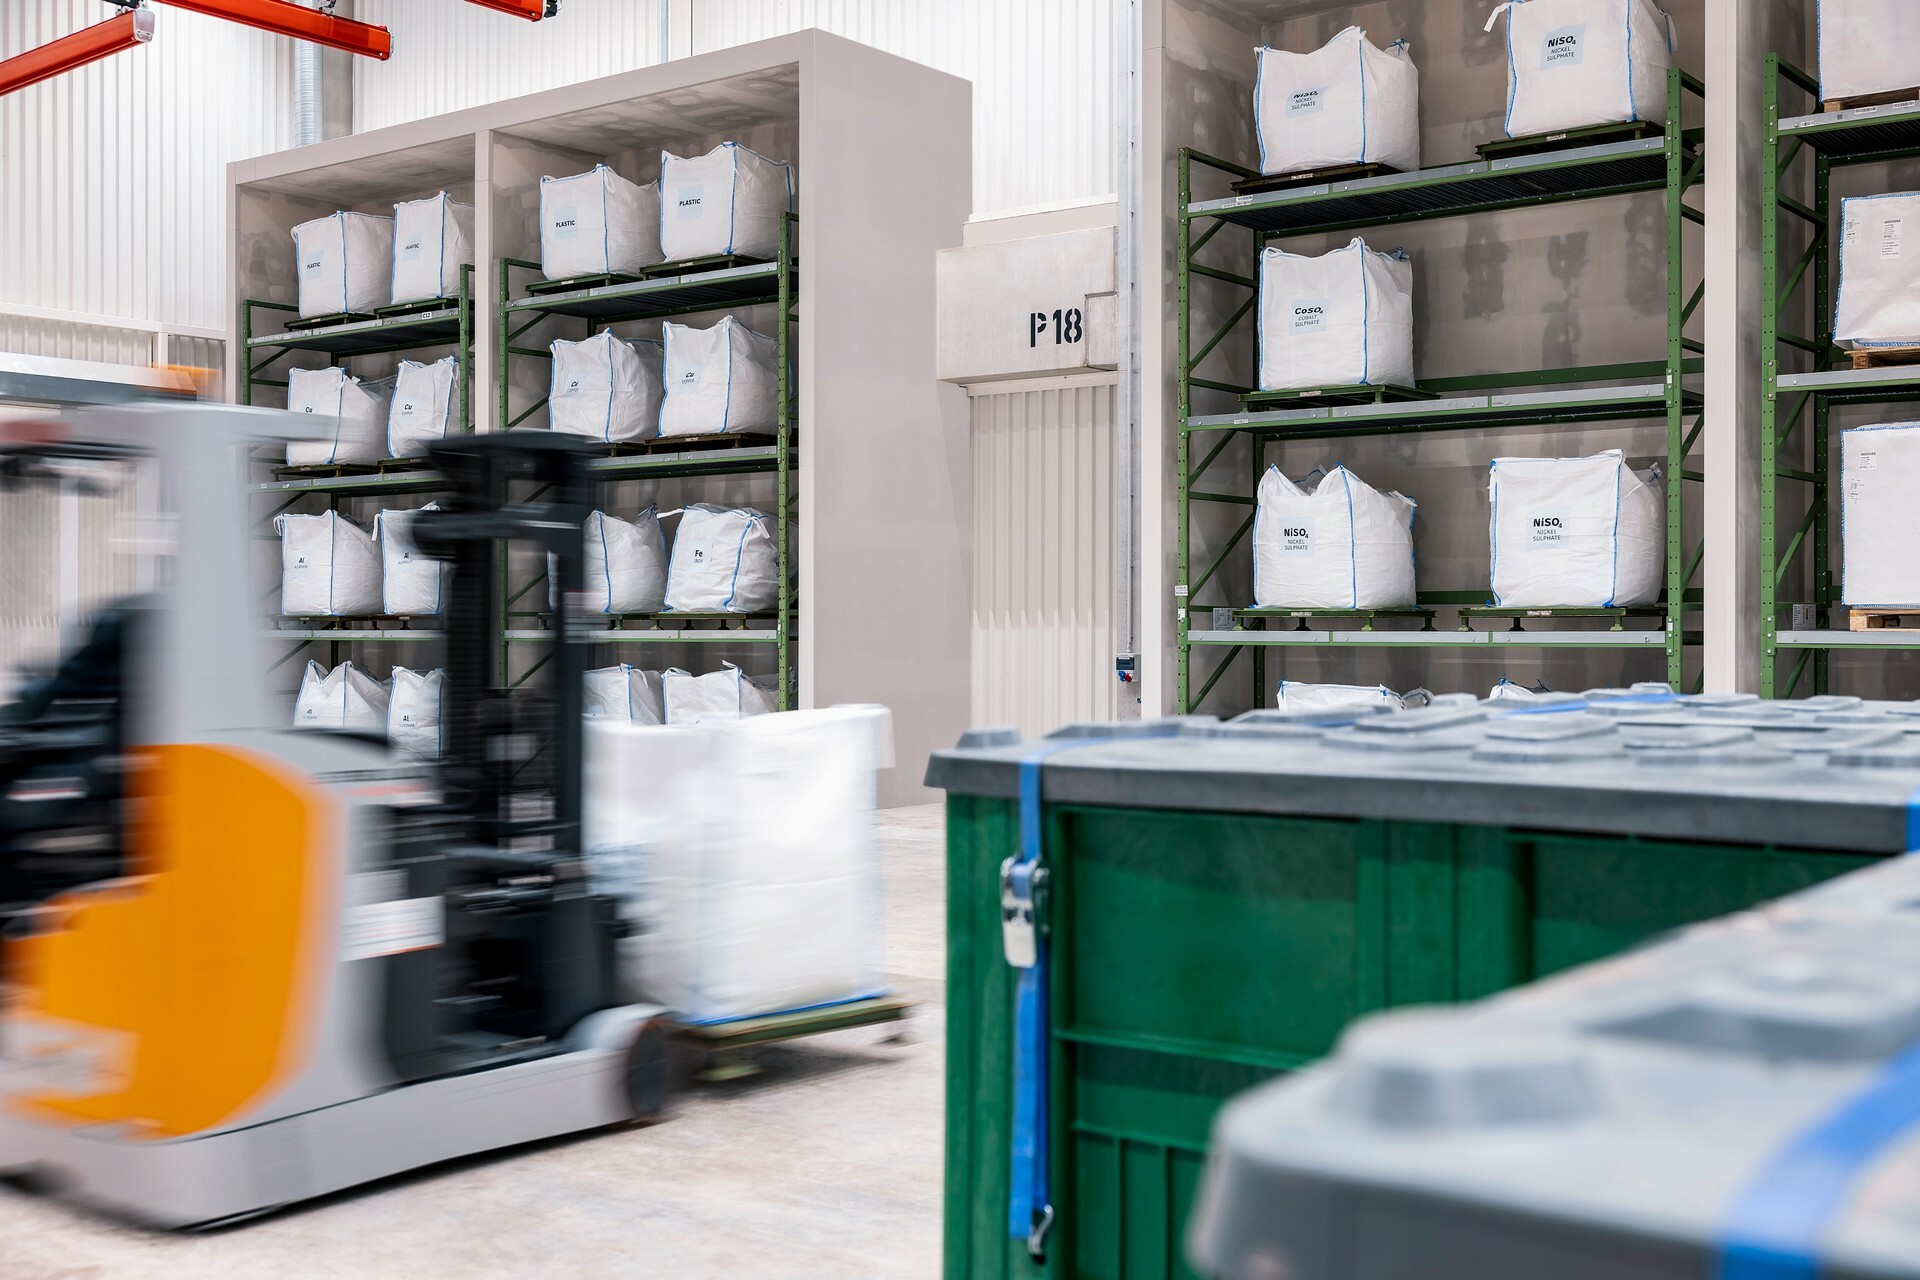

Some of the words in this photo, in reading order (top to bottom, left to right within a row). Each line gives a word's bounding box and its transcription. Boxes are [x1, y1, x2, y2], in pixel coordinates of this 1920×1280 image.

[1550, 46, 1572, 55] NICKEL
[1546, 51, 1576, 62] SULPHATE
[1291, 100, 1316, 111] SULPHATE
[679, 198, 701, 207] PLASTIC
[555, 219, 576, 228] PLASTIC
[306, 261, 321, 270] PLASTIC
[1298, 314, 1318, 322] COBALT
[1294, 319, 1320, 328] SULPHATE
[570, 380, 580, 388] Cu
[305, 406, 313, 414] Cu
[404, 403, 413, 411] Cu
[1533, 517, 1563, 529] NiSO4
[1532, 534, 1561, 542] SULPHATE
[694, 549, 703, 558] Fe
